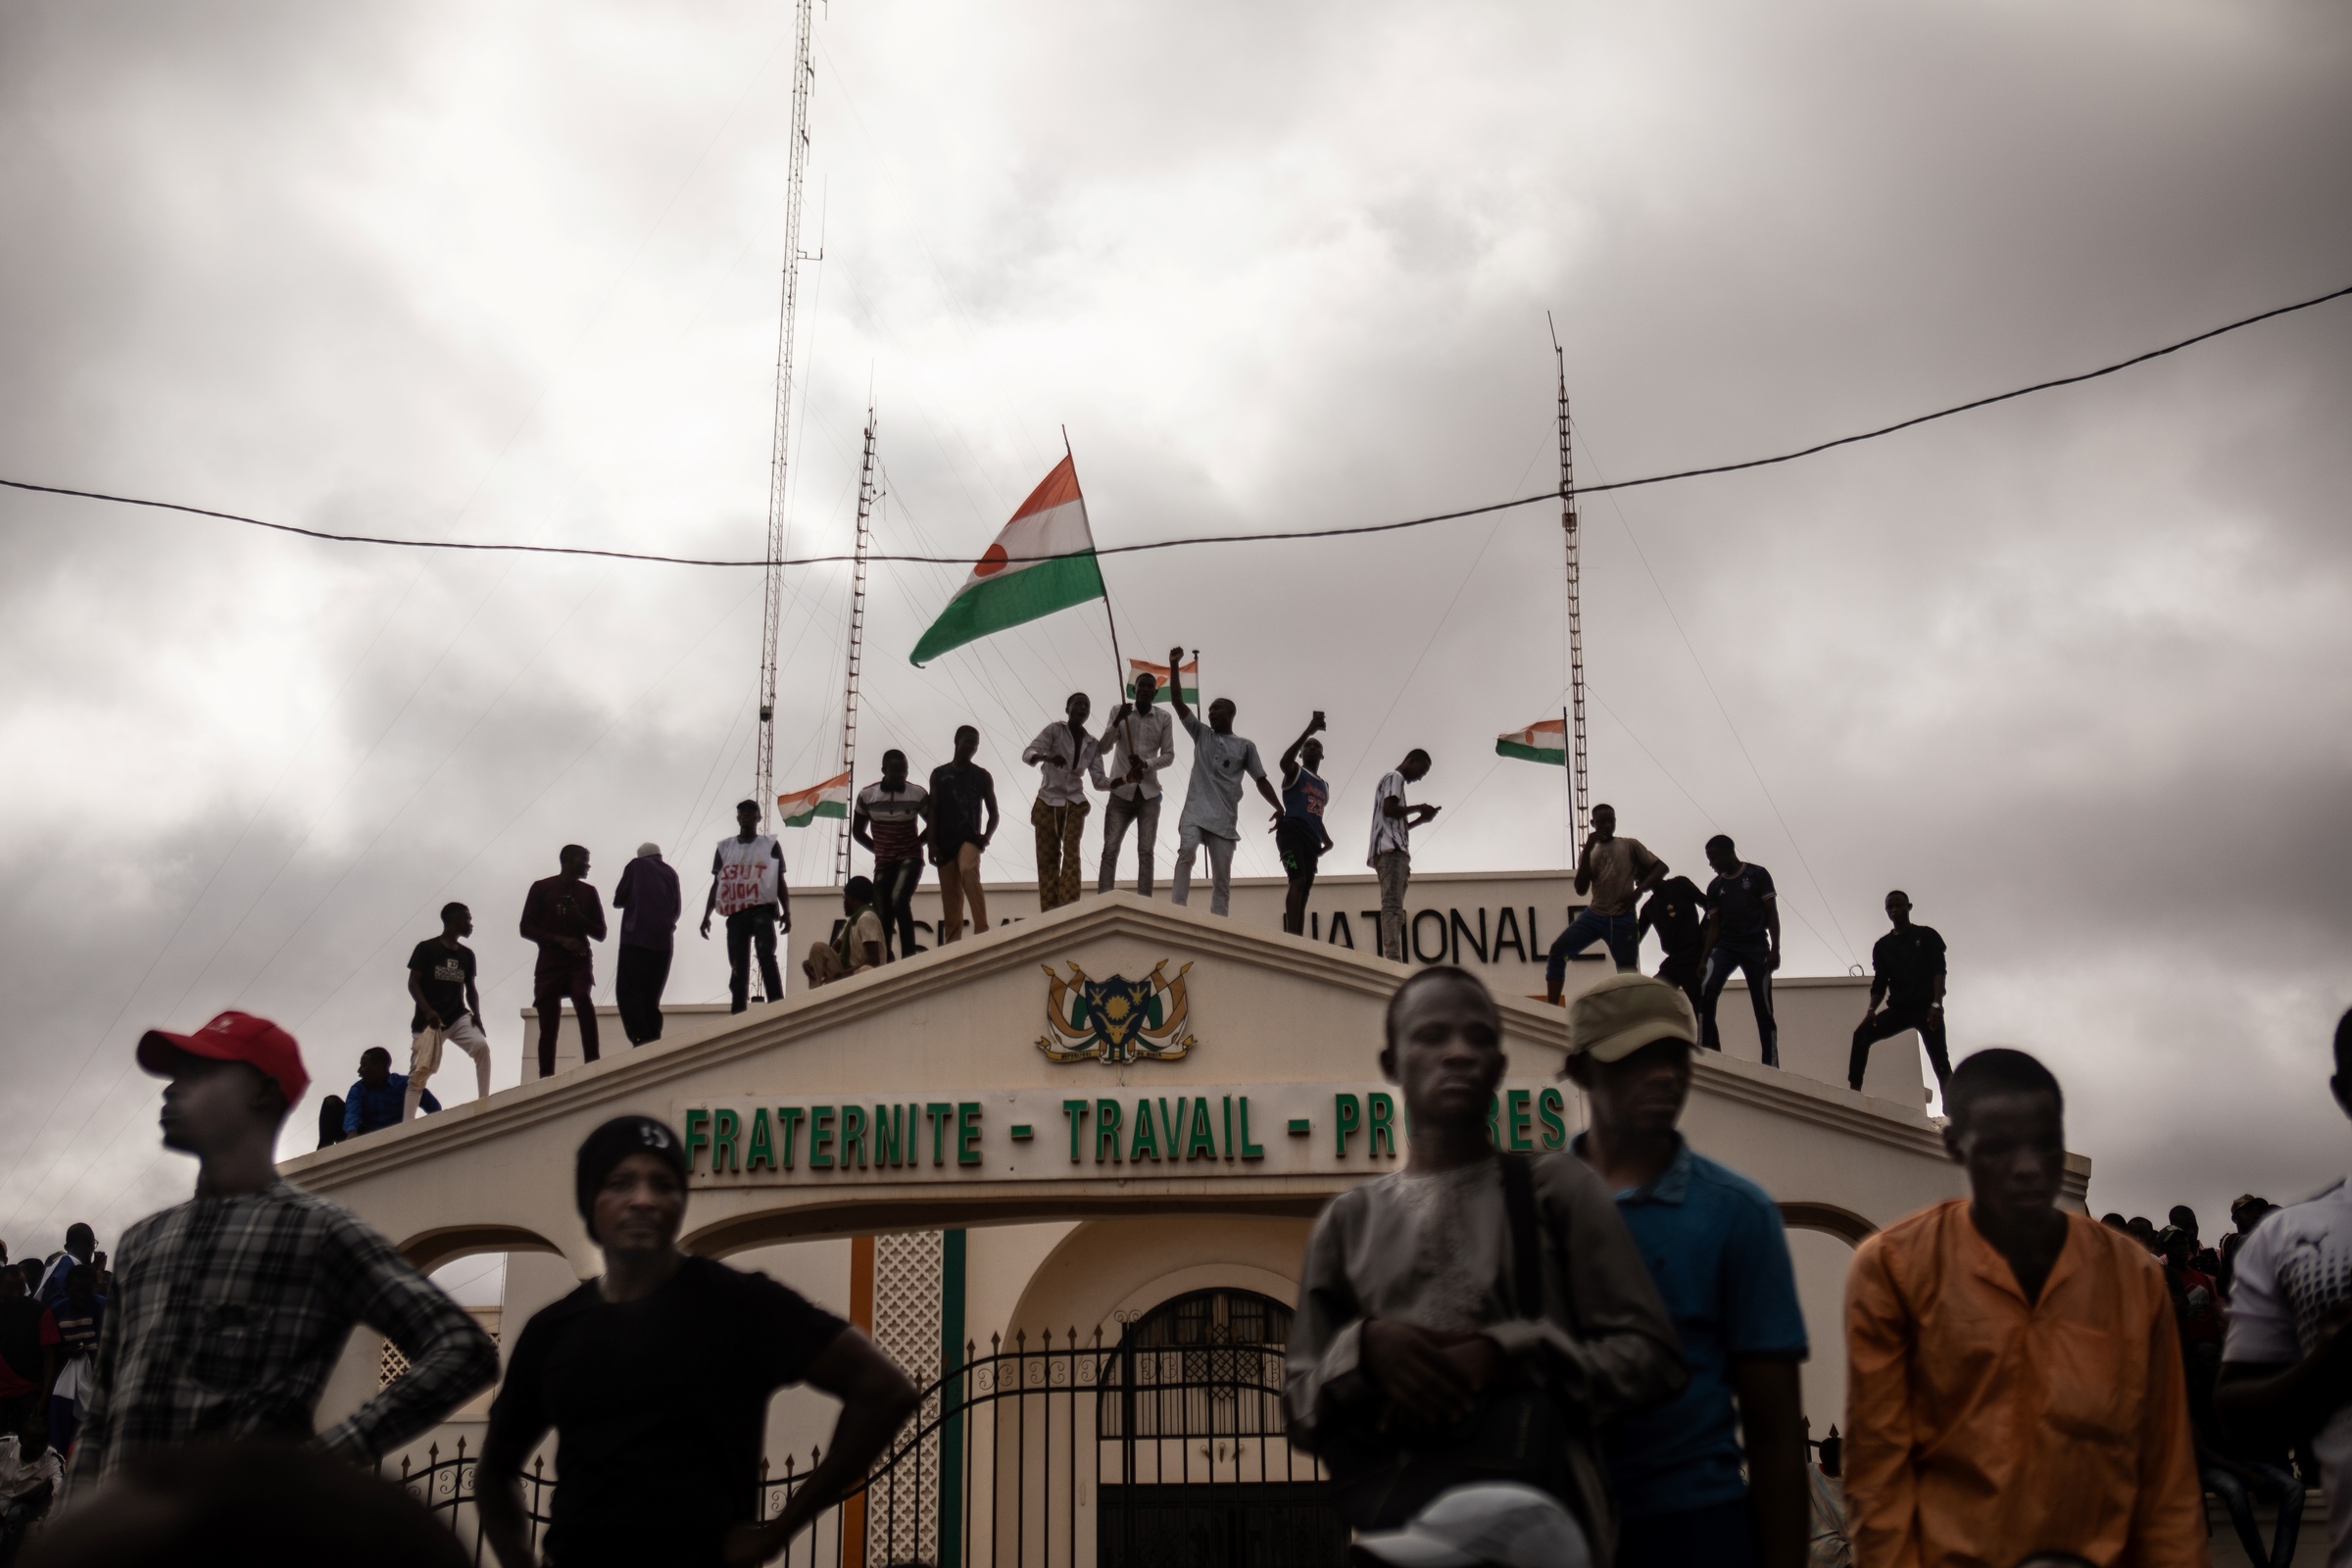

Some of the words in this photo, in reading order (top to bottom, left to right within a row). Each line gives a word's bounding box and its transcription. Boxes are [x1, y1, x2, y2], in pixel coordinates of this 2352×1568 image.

[686, 1102, 983, 1172] FRATERNITE
[1063, 1096, 1265, 1162] TRAVAIL
[1335, 1087, 1567, 1158] PRRES
